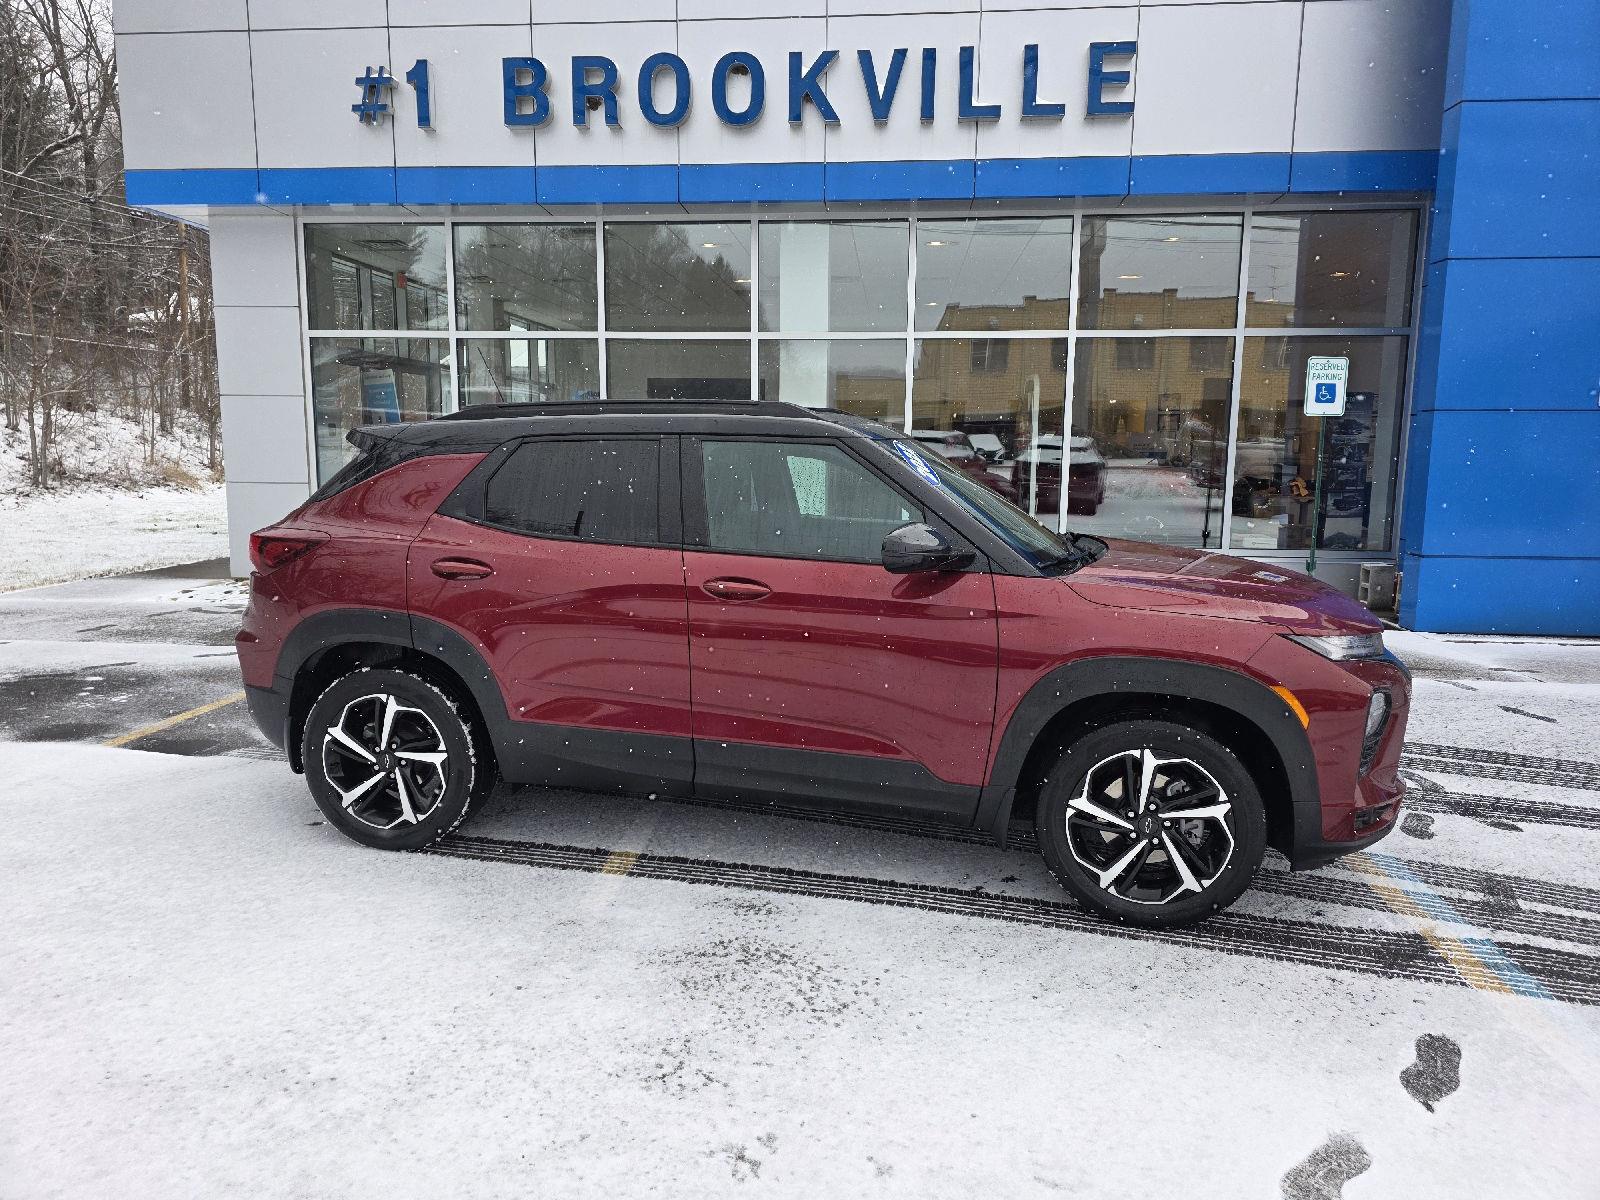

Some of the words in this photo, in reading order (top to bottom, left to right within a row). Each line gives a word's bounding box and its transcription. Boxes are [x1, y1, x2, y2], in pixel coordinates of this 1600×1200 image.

[352, 59, 435, 131] #1
[502, 41, 1137, 129] BROOKVILLE
[1310, 362, 1346, 371] RESERVED
[1311, 372, 1343, 381] PARKING
